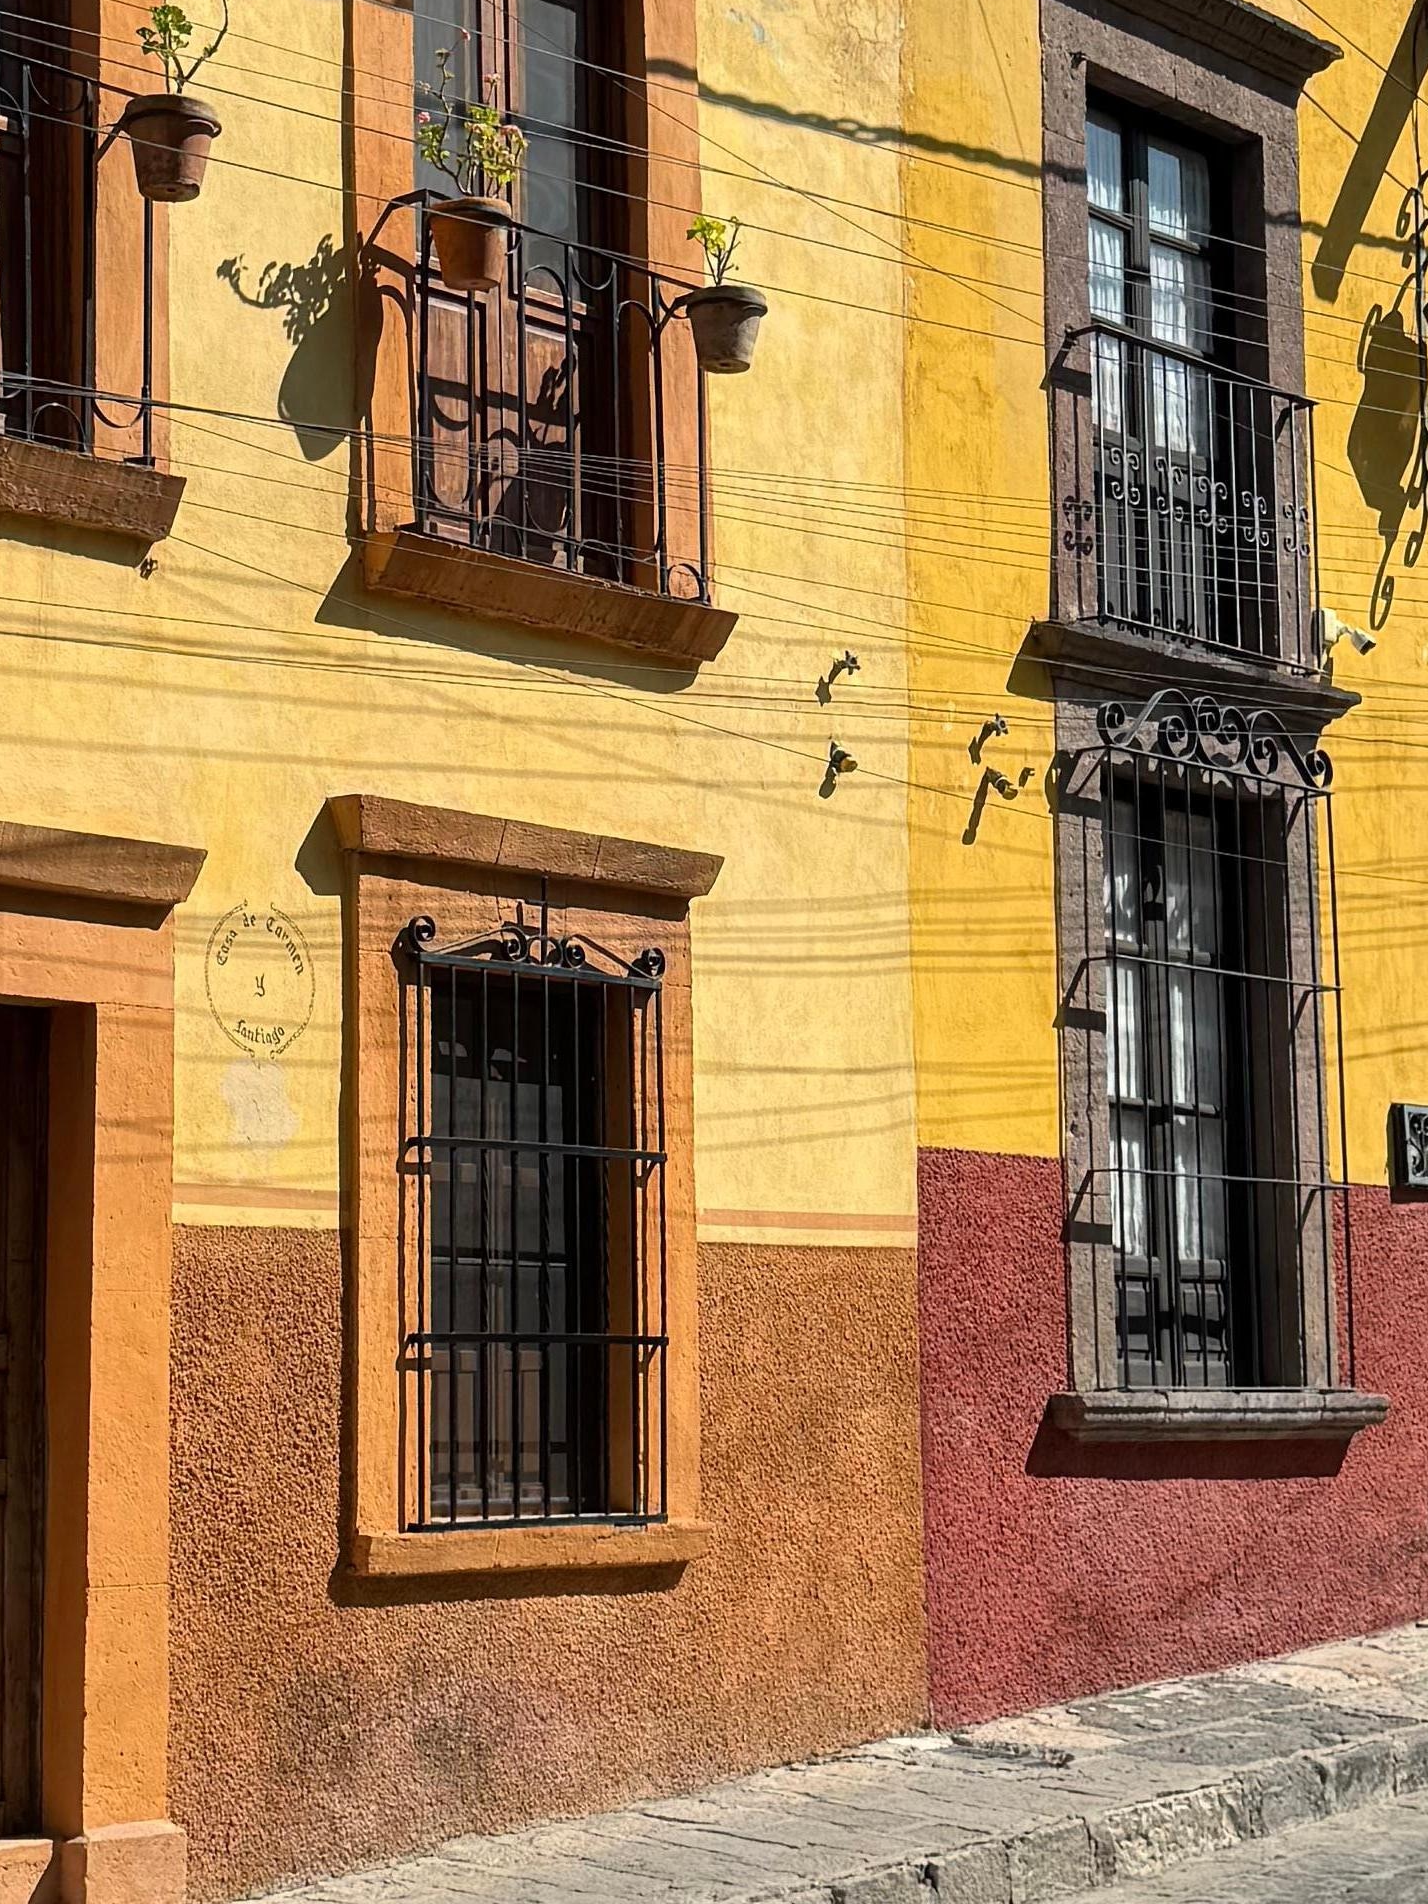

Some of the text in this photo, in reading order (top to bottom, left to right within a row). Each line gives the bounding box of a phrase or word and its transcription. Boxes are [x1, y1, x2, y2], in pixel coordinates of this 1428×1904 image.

[216, 912, 304, 976] Casa de Carmen
[232, 1019, 285, 1045] Santiago
